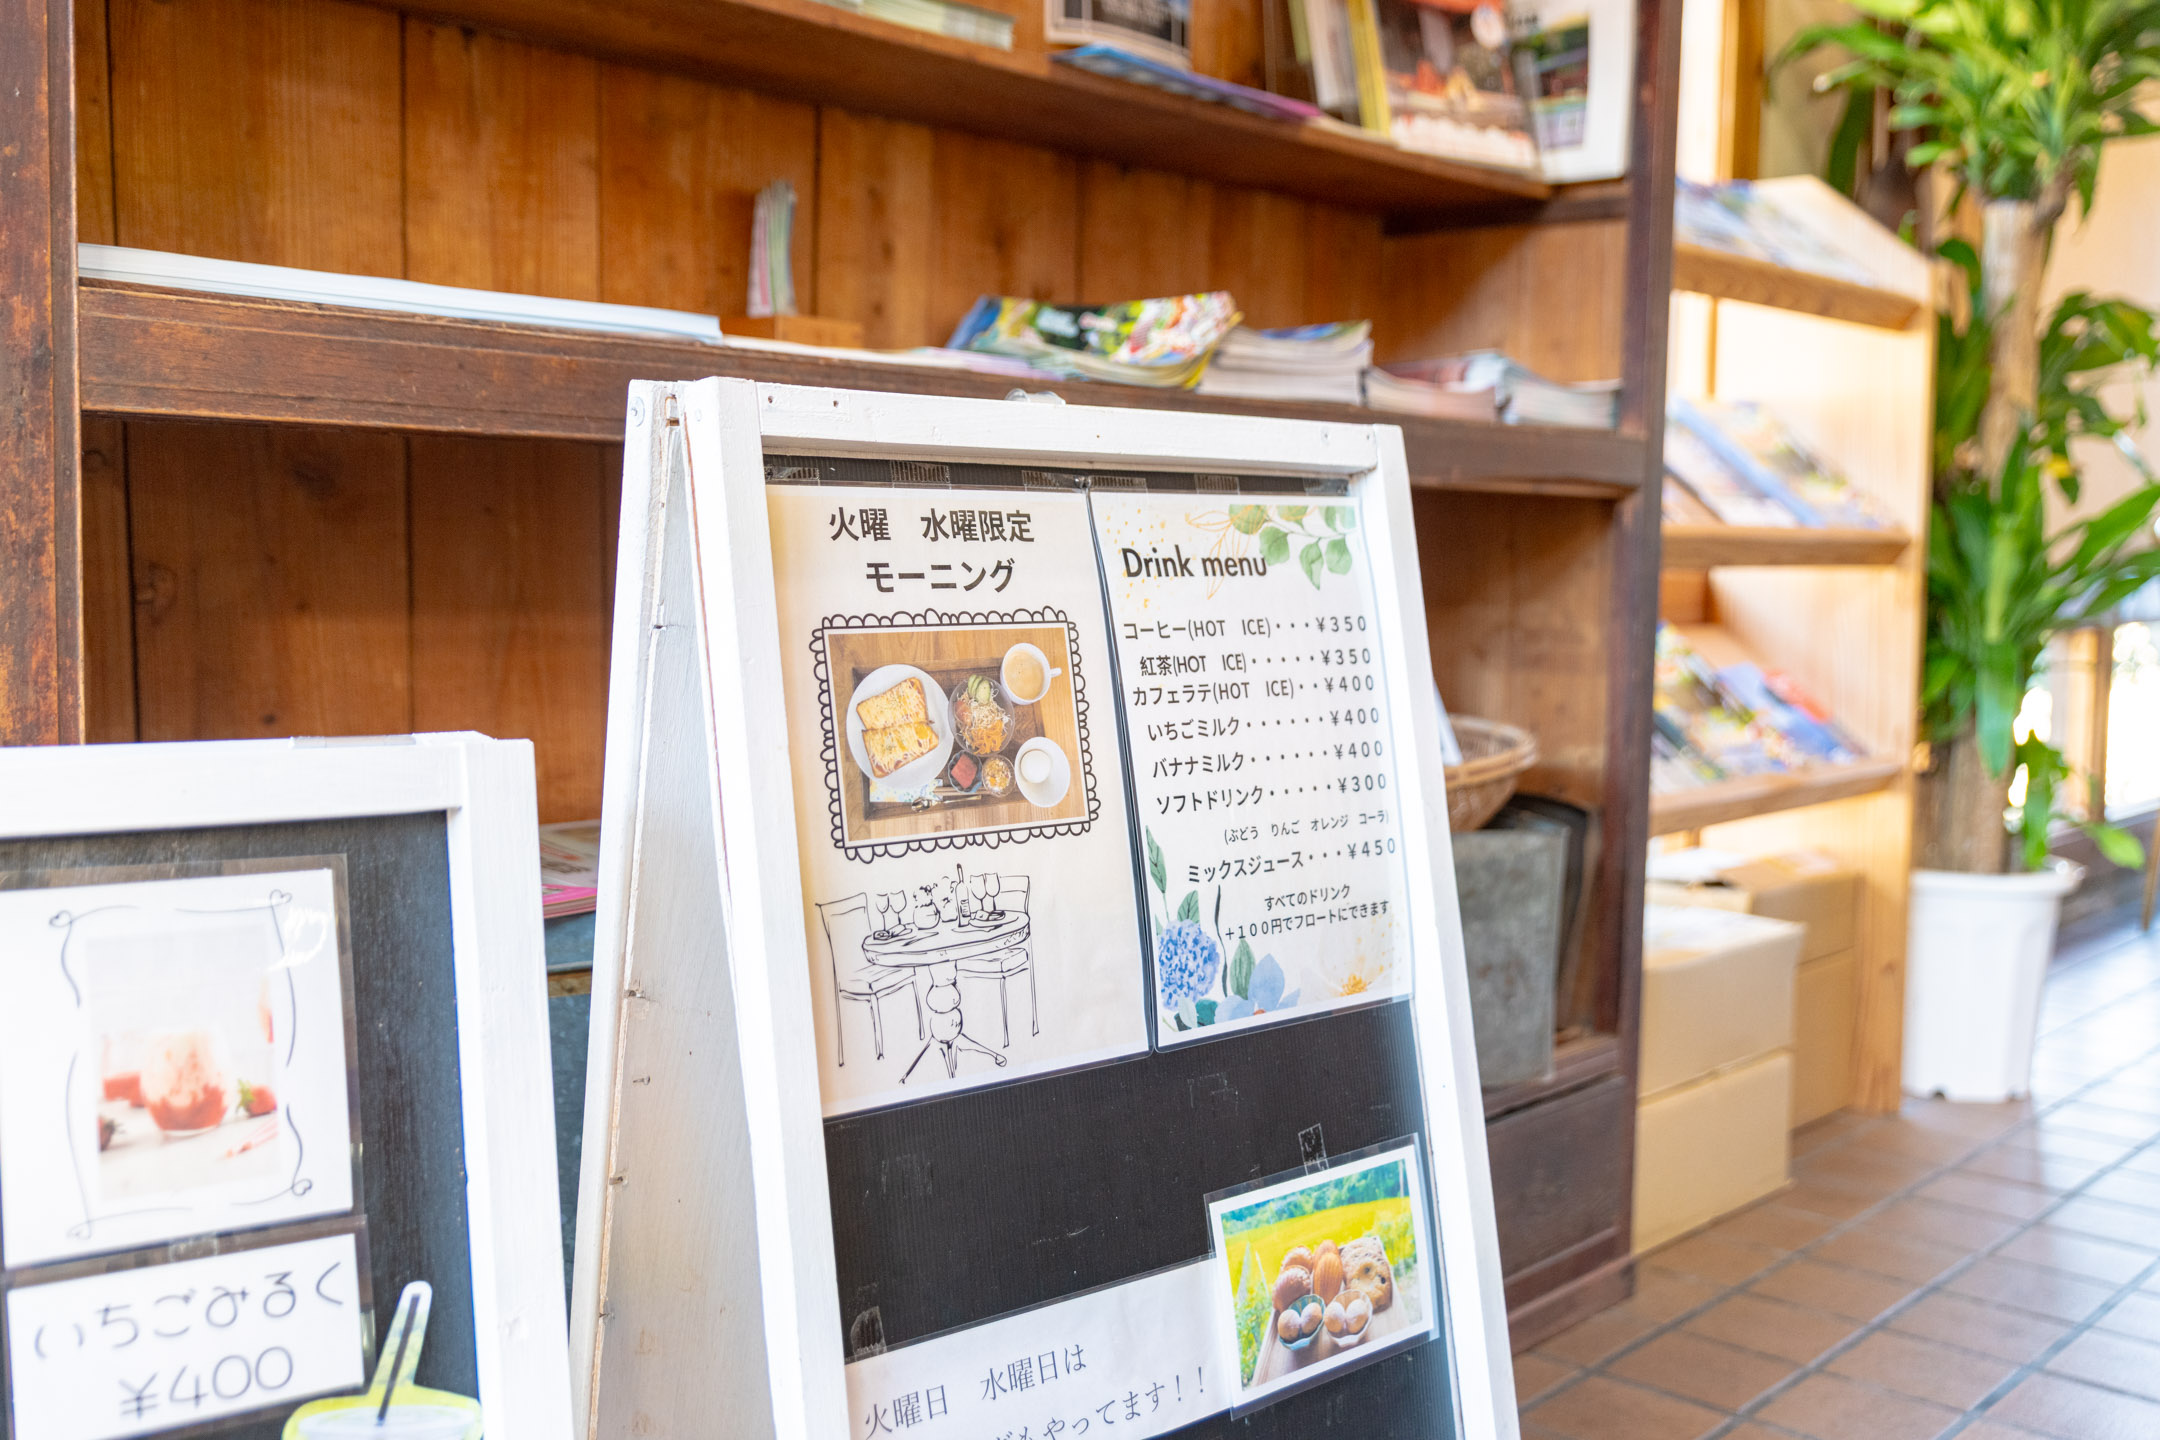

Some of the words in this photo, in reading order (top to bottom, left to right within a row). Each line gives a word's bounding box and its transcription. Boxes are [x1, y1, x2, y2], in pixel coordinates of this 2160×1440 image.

[829, 506, 892, 542] 火曜
[920, 507, 1036, 543] 水曜限定
[866, 557, 1016, 593] モーニング
[1121, 544, 1195, 578] Drink
[1201, 556, 1267, 577] menu
[1264, 884, 1351, 912] すべてのドリンク
[34, 1261, 344, 1359] いちごみるく
[118, 1345, 294, 1420] ¥400
[864, 1384, 949, 1440] 火曜日
[980, 1343, 1088, 1401] 水曜日は
